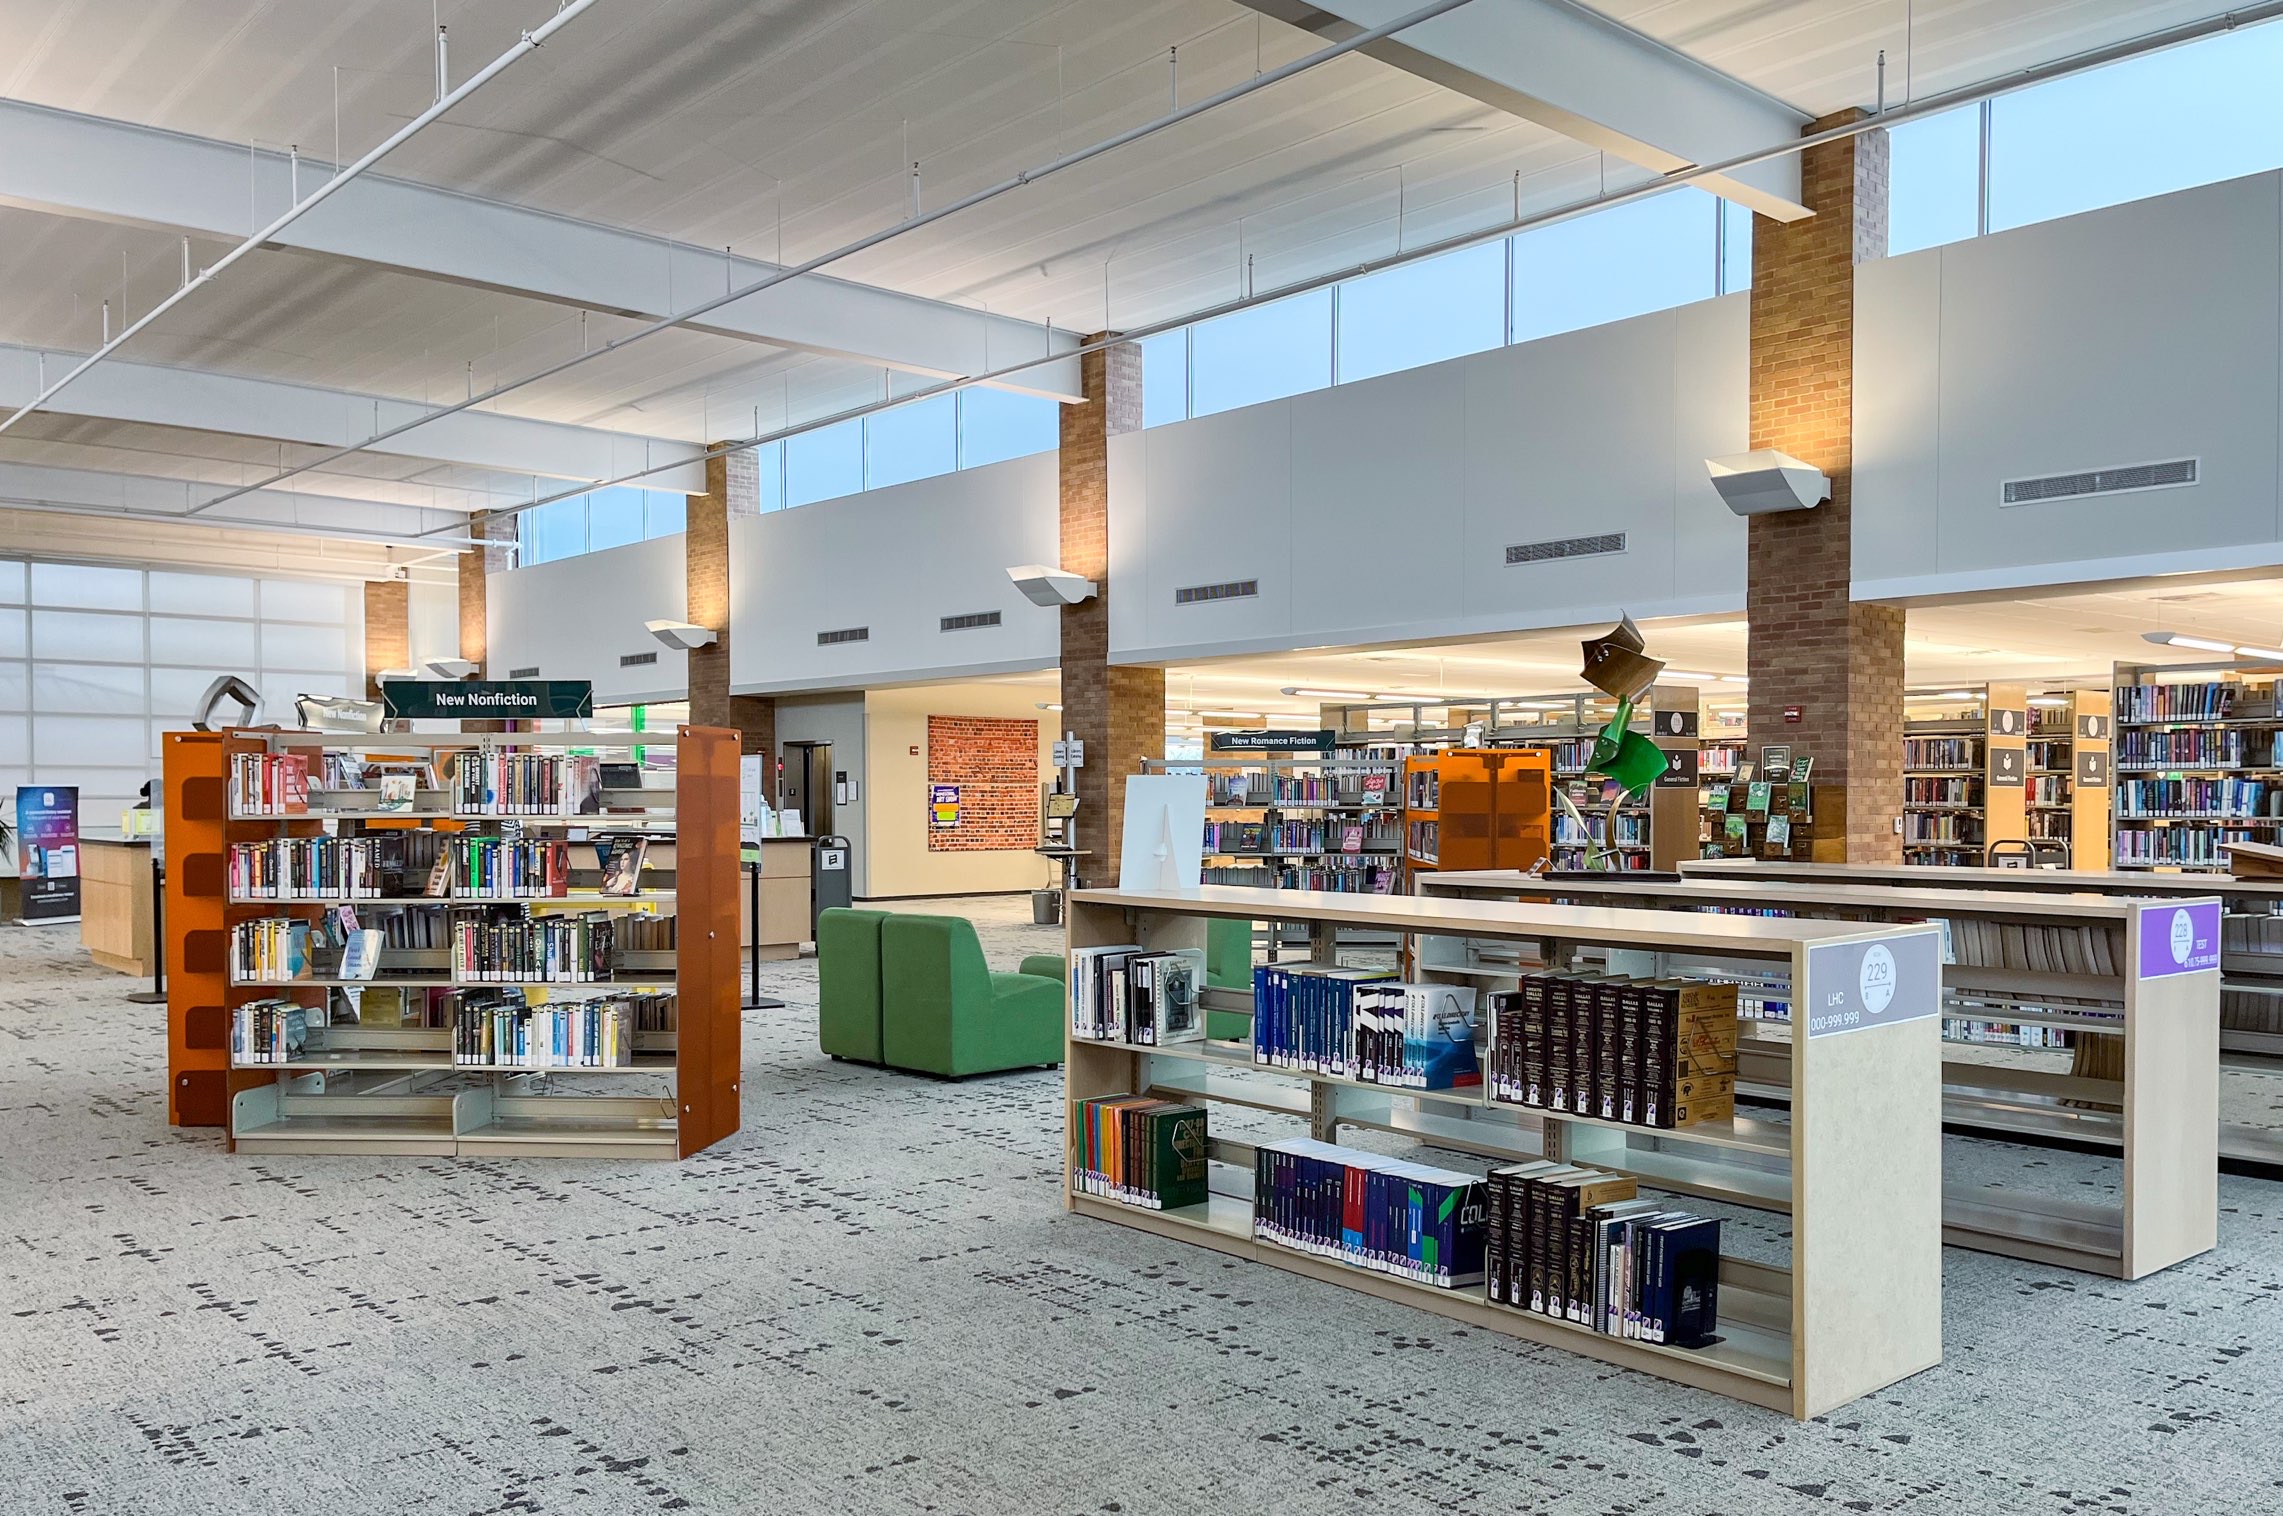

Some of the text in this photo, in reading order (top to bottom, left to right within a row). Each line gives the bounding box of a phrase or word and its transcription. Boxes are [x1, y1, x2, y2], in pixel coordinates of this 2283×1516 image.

[436, 692, 538, 707] New Nonfiction
[1231, 736, 1317, 745] New Romance Fiction
[1867, 962, 1888, 982] 229
[1828, 991, 1844, 1007] LHC
[1811, 1011, 1860, 1032] 000-999.999
[1461, 1204, 1488, 1225] COL
